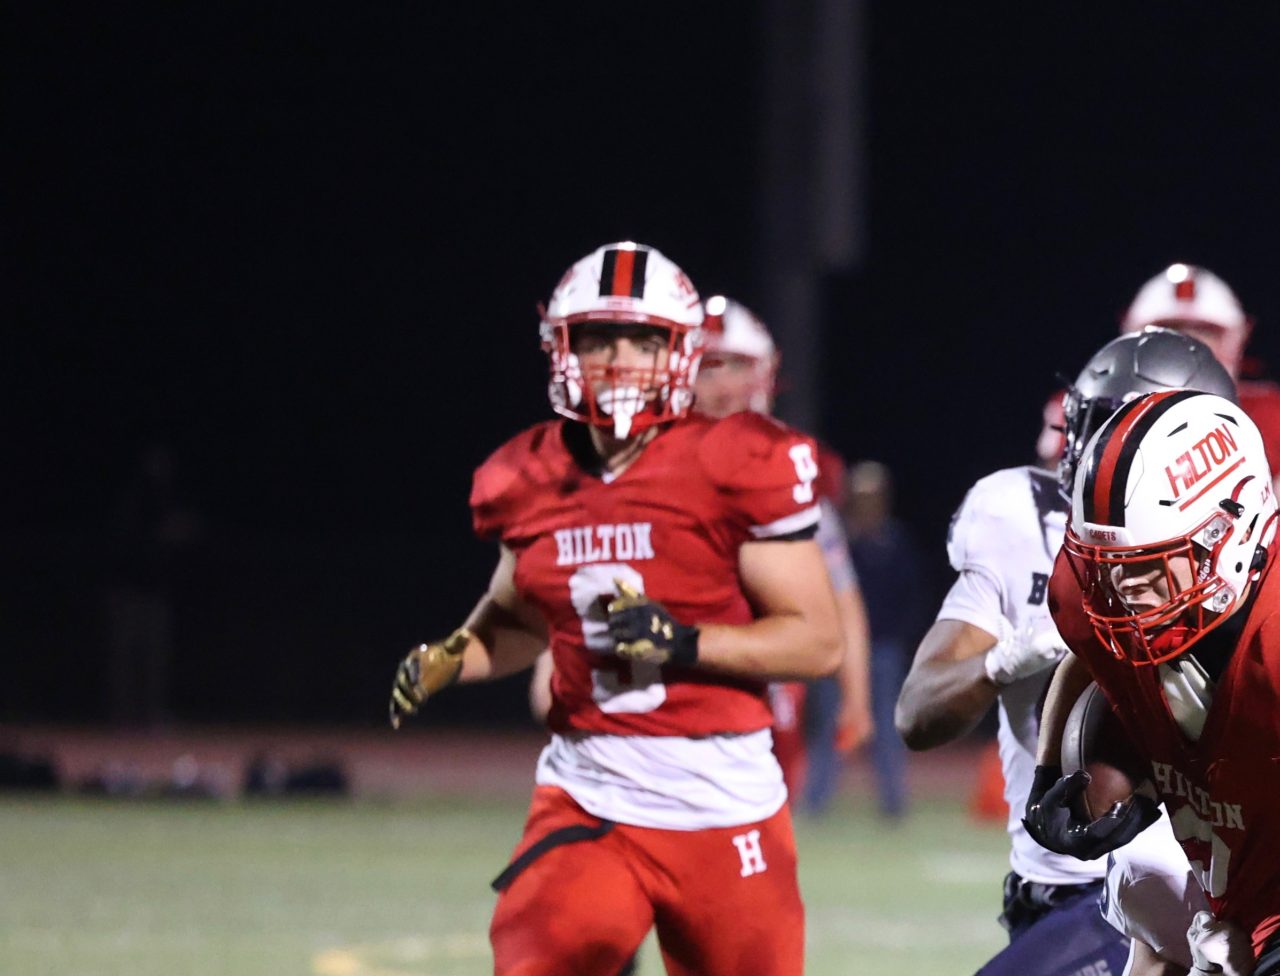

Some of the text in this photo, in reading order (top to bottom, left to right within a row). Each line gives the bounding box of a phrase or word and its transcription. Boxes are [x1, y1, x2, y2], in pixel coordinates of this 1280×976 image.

[788, 443, 818, 505] 9
[1164, 422, 1239, 499] HILTON
[554, 522, 655, 566] HILTON
[732, 829, 768, 878] H
